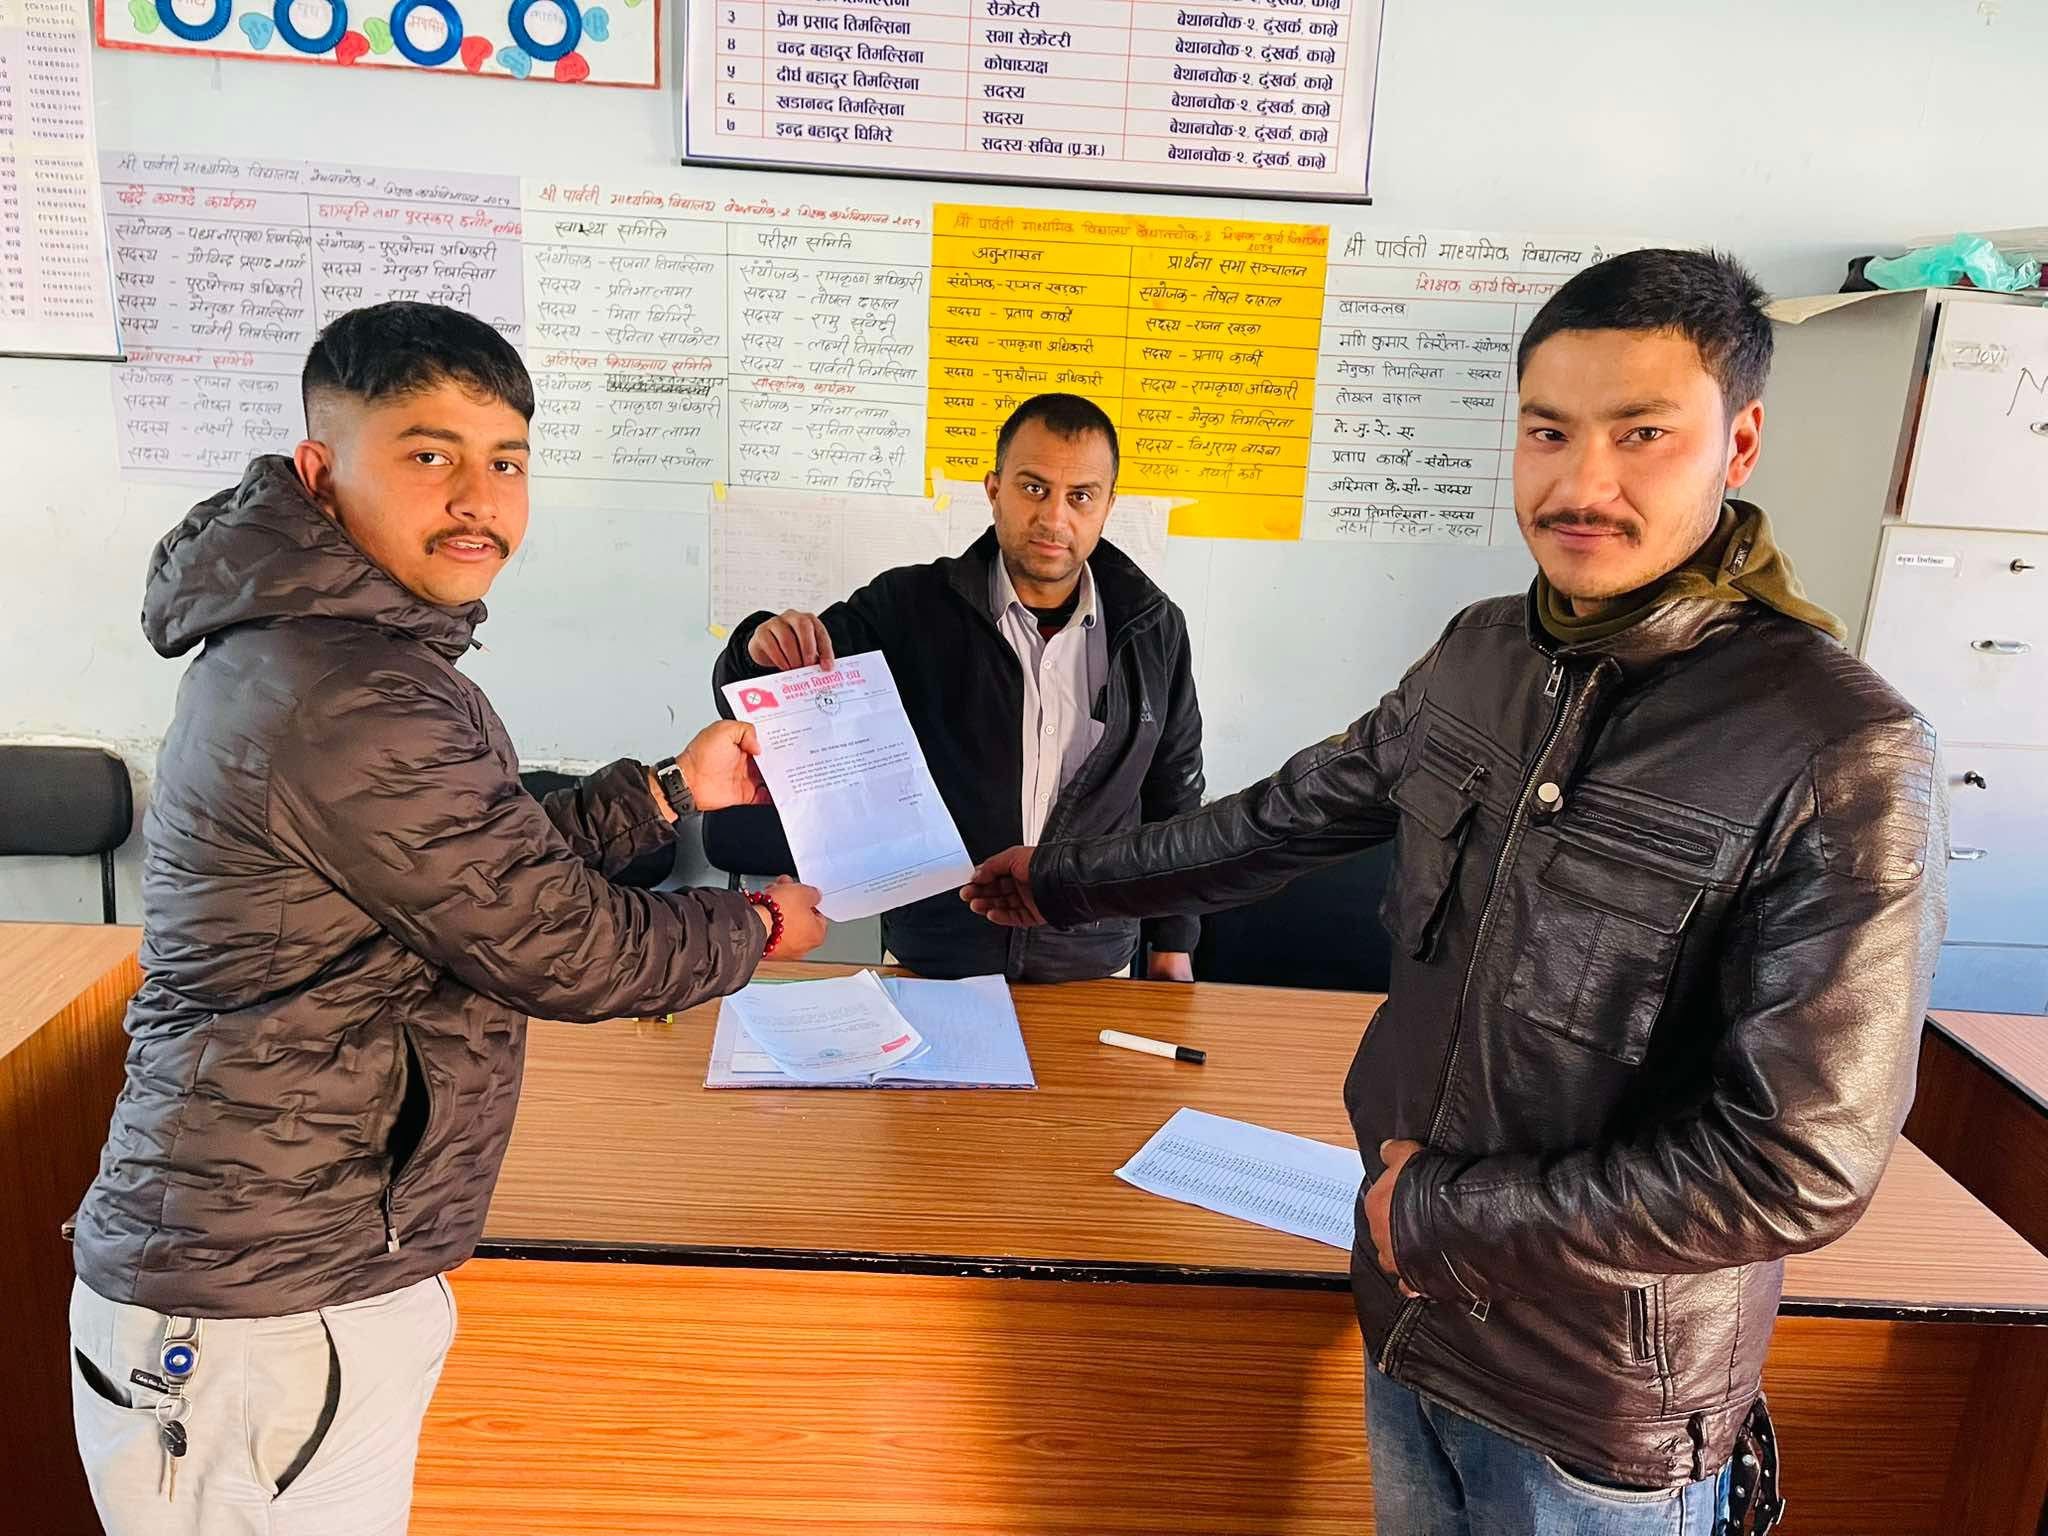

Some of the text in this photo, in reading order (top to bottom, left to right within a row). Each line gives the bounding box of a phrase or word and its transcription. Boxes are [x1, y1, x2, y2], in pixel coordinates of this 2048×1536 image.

[728, 11, 735, 23] ३
[777, 11, 911, 35] प्रेम प्रसाद तिमल्सिना
[727, 38, 735, 50] ४
[985, 30, 1012, 43] सभा
[777, 41, 924, 64] चन्द्र बहादुर तिमल्सिना
[727, 65, 735, 79] ५
[984, 54, 1048, 74] कोषाध्यक्ष
[776, 66, 919, 91] दीर्घ बहादुर तिमल्सिना
[727, 93, 735, 105] ६
[983, 84, 1024, 98] सदस्य
[776, 95, 904, 116] खडानन्द तिमल्सिना
[726, 118, 735, 131] ७
[983, 111, 1024, 125] सदस्य
[776, 121, 893, 142] इन्द्र बहादुर घिमिरे
[540, 184, 556, 203] श्री
[564, 184, 600, 205] पार्वती
[979, 216, 1014, 231] पार्वती
[1344, 232, 1365, 258] श्री
[1375, 235, 1427, 258] पार्वती
[1438, 238, 1509, 262] माध्यमिक
[1522, 242, 1583, 264] विद्यालय
[1168, 252, 1212, 270] प्रार्थना
[1220, 260, 1245, 274] सभा
[1416, 272, 1461, 292] शिक्षक
[744, 286, 786, 301] सदस्य
[743, 308, 784, 326] सदस्य
[947, 306, 980, 316] सदस्य
[1004, 307, 1033, 320] प्रताप
[1147, 317, 1180, 331] सदस्य
[741, 333, 784, 349] सदस्य
[946, 336, 1094, 353] सदस्य अधिकारी
[1372, 336, 1409, 352] कुमार
[1143, 347, 1172, 360] सदस्य
[1192, 349, 1224, 362] प्रताप
[741, 356, 784, 372] सदस्य
[1336, 360, 1502, 380] मेनुका तिमल्सिना सदस्य
[944, 367, 1104, 386] सदस्य अधिकारी
[1141, 378, 1176, 392] सदस्य
[1246, 379, 1298, 400] अधिकारी
[1137, 408, 1171, 425] सदस्य
[1136, 437, 1172, 454] सदस्य
[1332, 449, 1473, 468] प्रताप कार्की संयोजक
[1329, 477, 1378, 492] अस्मिता
